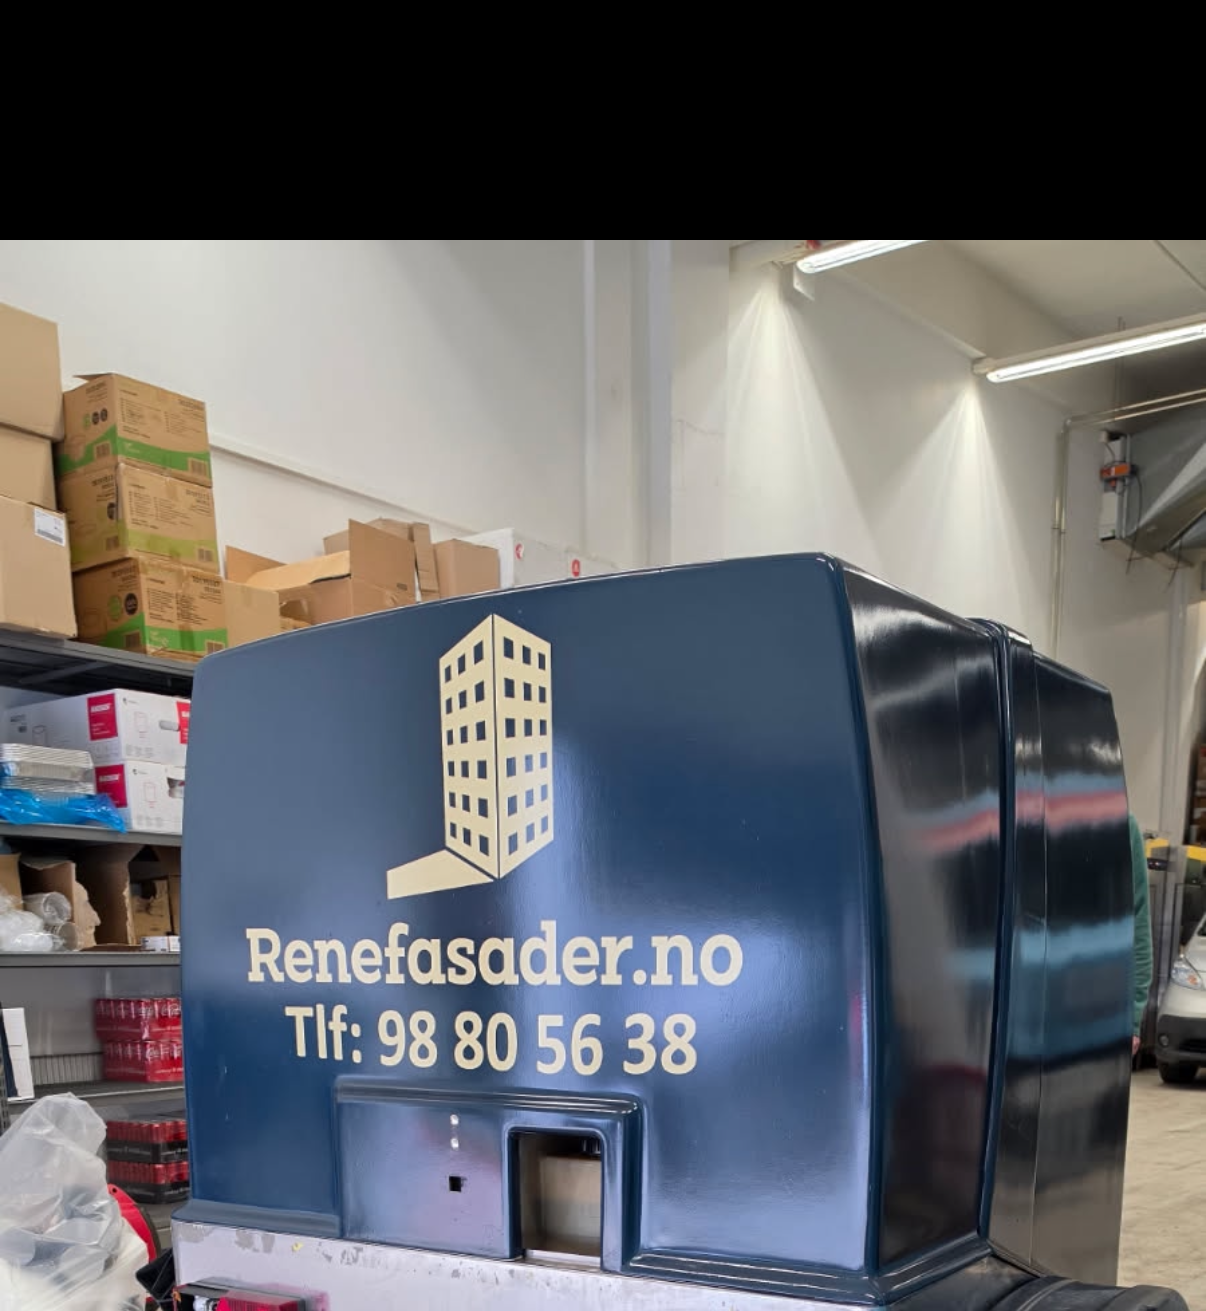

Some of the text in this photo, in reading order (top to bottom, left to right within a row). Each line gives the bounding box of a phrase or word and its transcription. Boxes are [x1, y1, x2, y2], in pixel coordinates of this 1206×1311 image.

[246, 920, 743, 986] Renefasader.no
[285, 1003, 697, 1075] Tlf: 98 80 56 38
